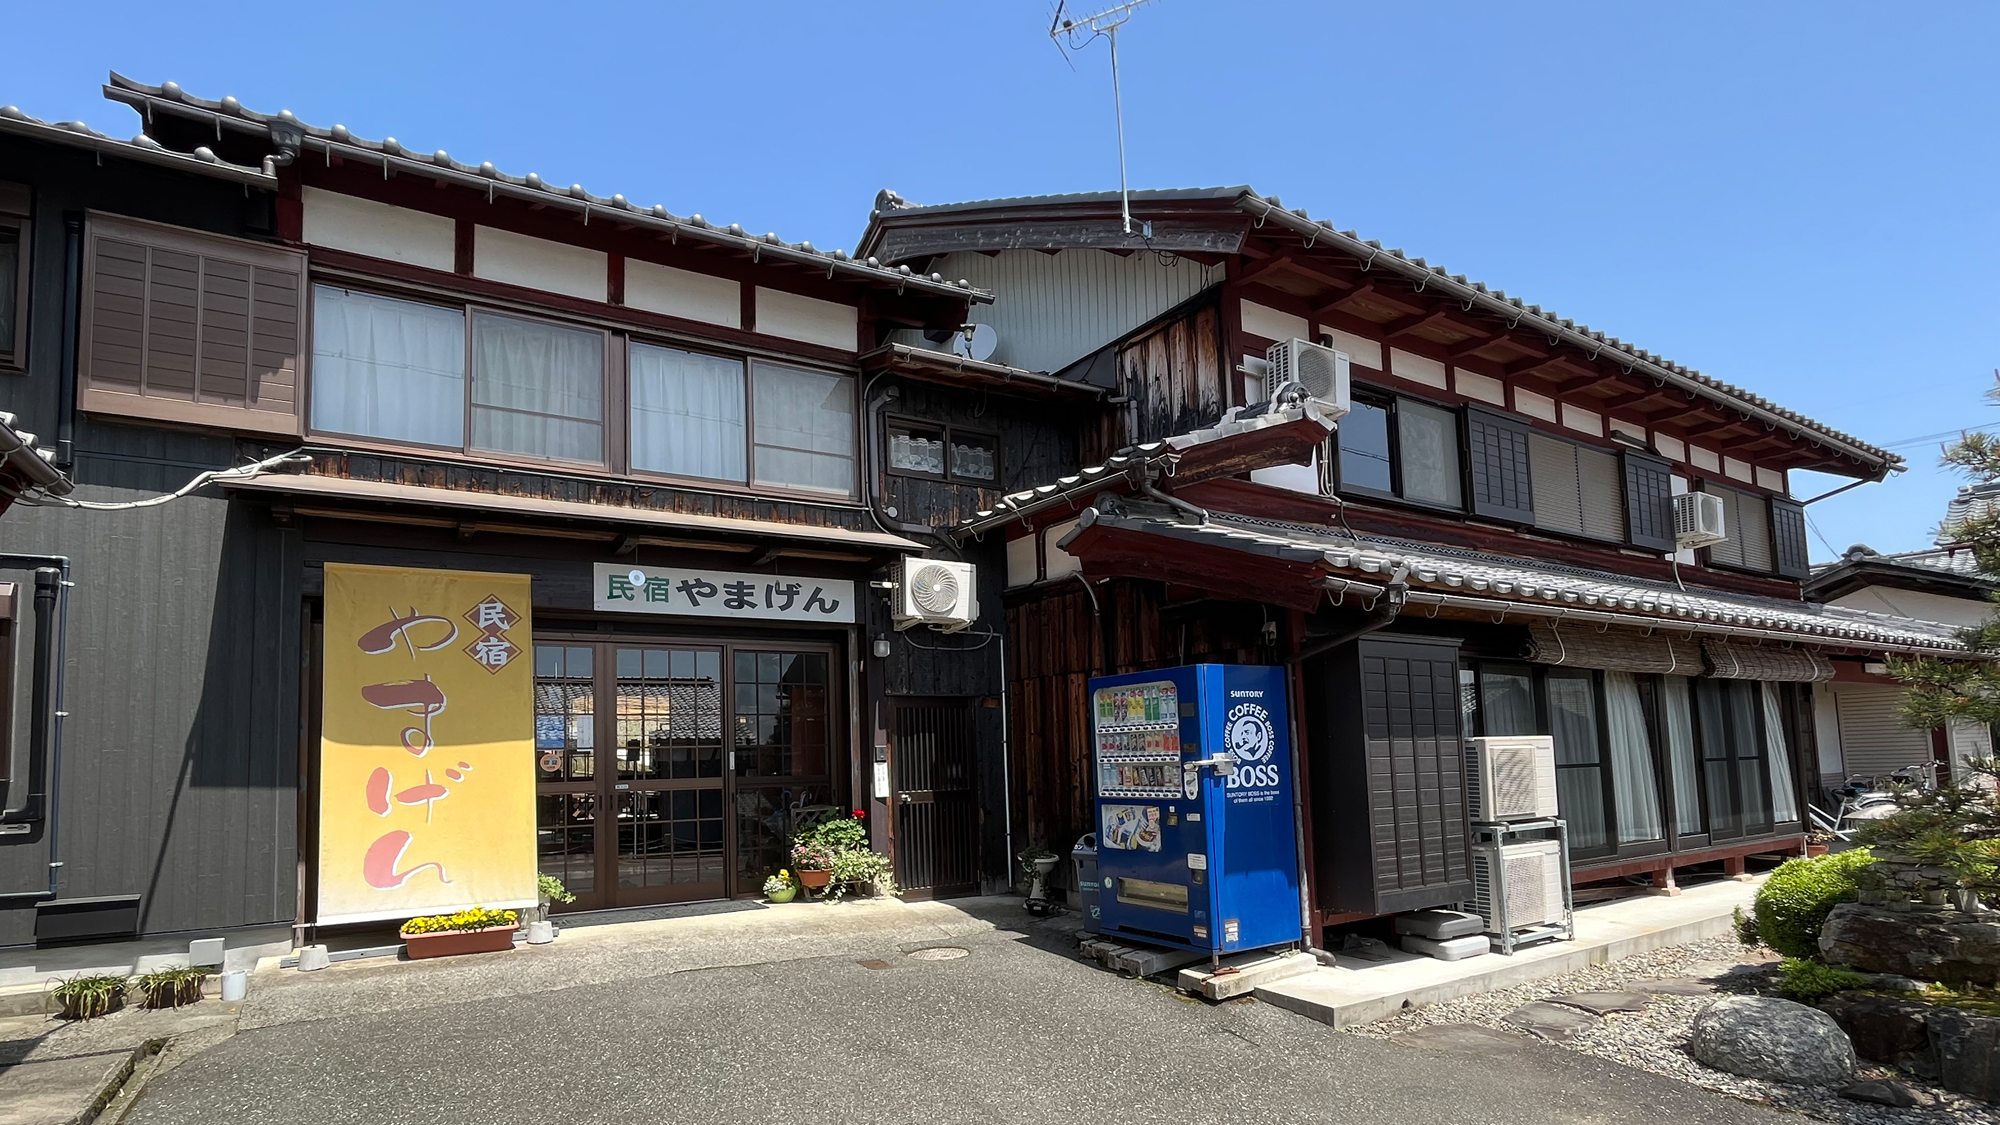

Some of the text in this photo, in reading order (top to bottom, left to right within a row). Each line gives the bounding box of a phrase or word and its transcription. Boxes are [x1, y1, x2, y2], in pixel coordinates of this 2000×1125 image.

[475, 601, 512, 667] 民宿
[1230, 690, 1264, 698] SUNTORY
[1228, 703, 1268, 722] COFFEE
[357, 605, 474, 891] やまげん
[1225, 721, 1233, 748] COFFEE
[1261, 720, 1275, 764] BOSS COFFEE
[1226, 764, 1279, 789] BOSS
